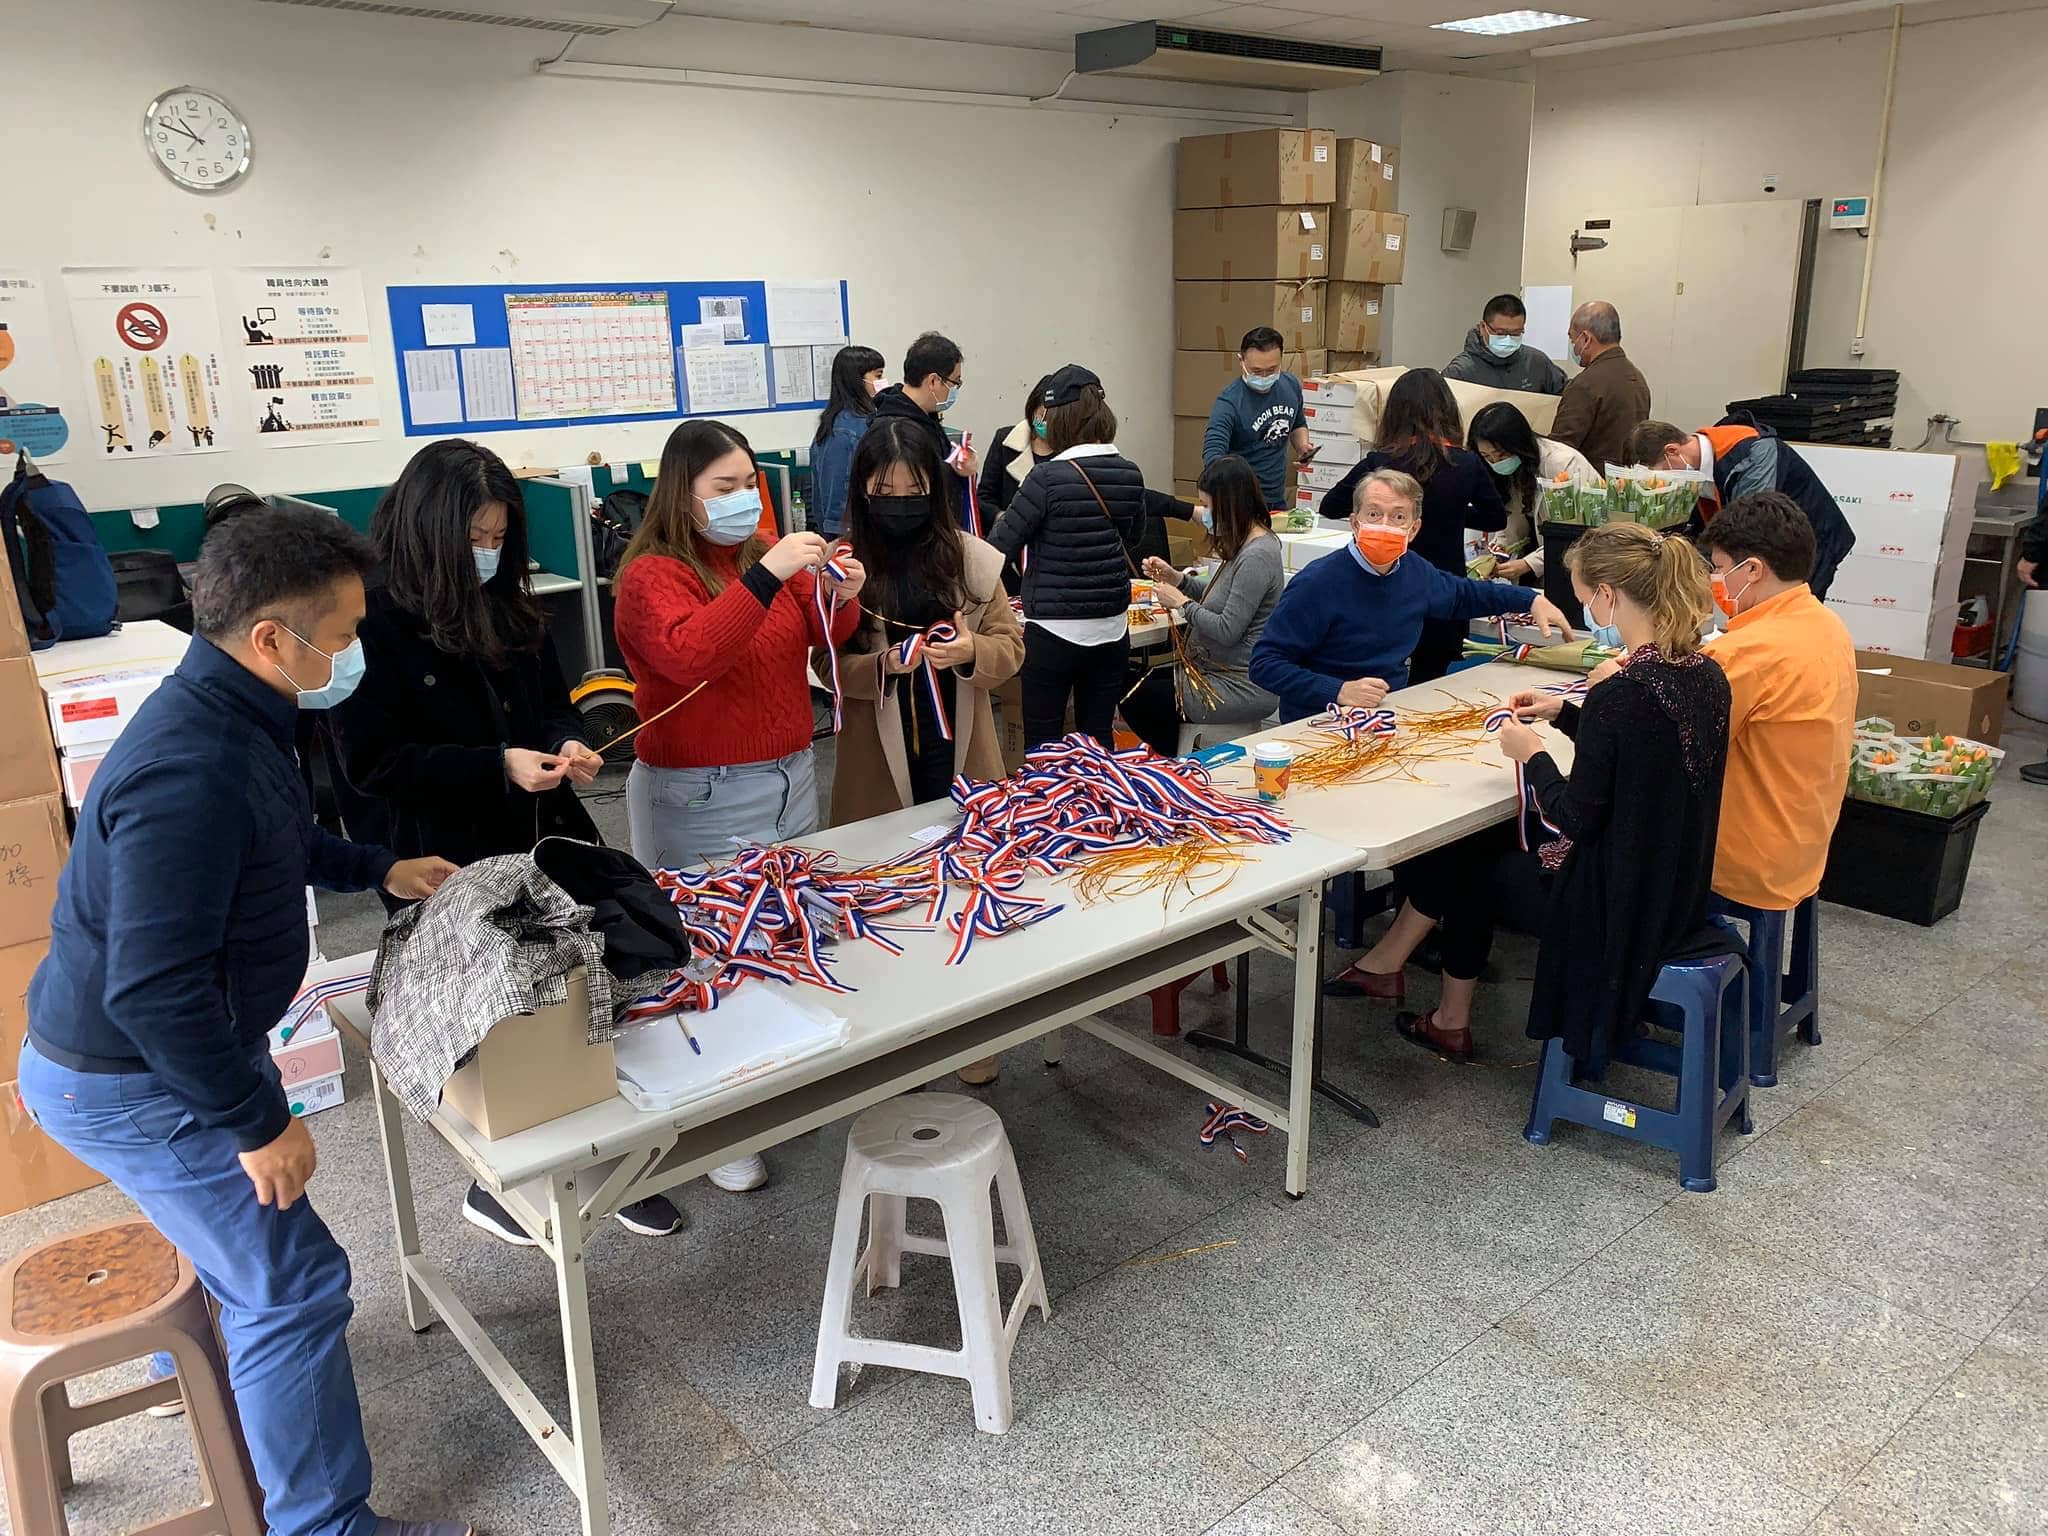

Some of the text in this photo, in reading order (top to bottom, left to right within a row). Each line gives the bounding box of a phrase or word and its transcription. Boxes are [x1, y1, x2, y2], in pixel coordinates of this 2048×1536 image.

[170, 105, 179, 116] 11
[185, 99, 199, 112] 12
[208, 106, 213, 117] 1
[217, 117, 228, 129] 2
[157, 132, 168, 143] 9
[226, 134, 237, 146] 3
[166, 148, 176, 160] 8
[224, 151, 234, 161] 4
[180, 161, 190, 172] 7
[197, 166, 209, 177] 6
[213, 161, 224, 174] 5
[1252, 405, 1295, 432] MOON BEAR
